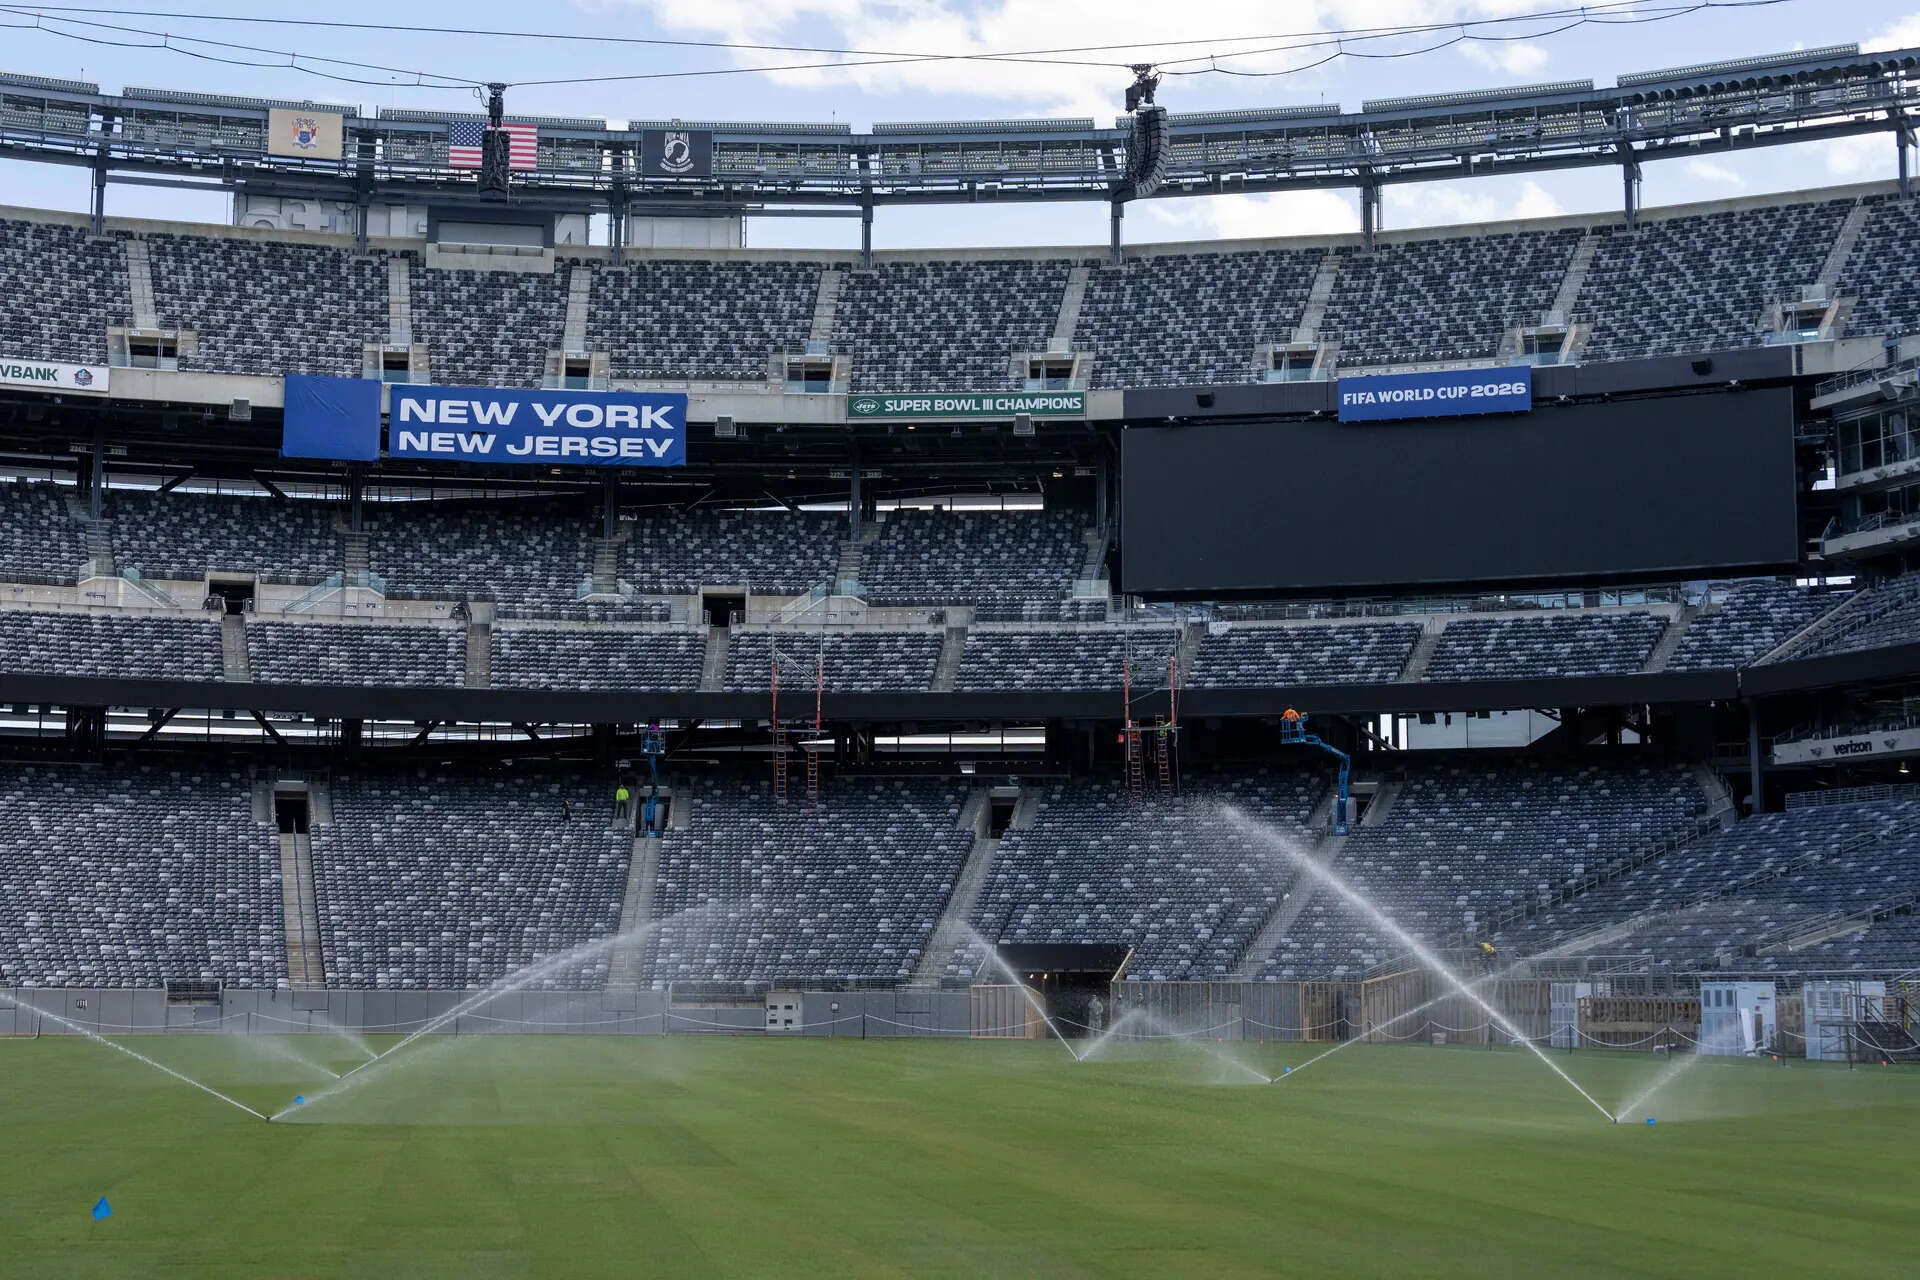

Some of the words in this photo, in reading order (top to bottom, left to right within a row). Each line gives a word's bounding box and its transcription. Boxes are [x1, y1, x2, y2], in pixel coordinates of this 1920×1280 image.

[884, 400, 931, 412] SUPER
[934, 399, 980, 411] BOWL
[983, 399, 993, 411] III
[996, 397, 1082, 410] CHAMPIONS
[1343, 391, 1376, 405] FIFA
[1378, 388, 1434, 403] WORLD
[1437, 386, 1468, 399] CUP
[1470, 382, 1526, 397] 2026
[399, 398, 520, 426] NEW
[531, 402, 675, 430] YORK
[398, 431, 496, 454] NEW
[506, 435, 674, 458] JERSEY
[1833, 740, 1872, 754] verizon
